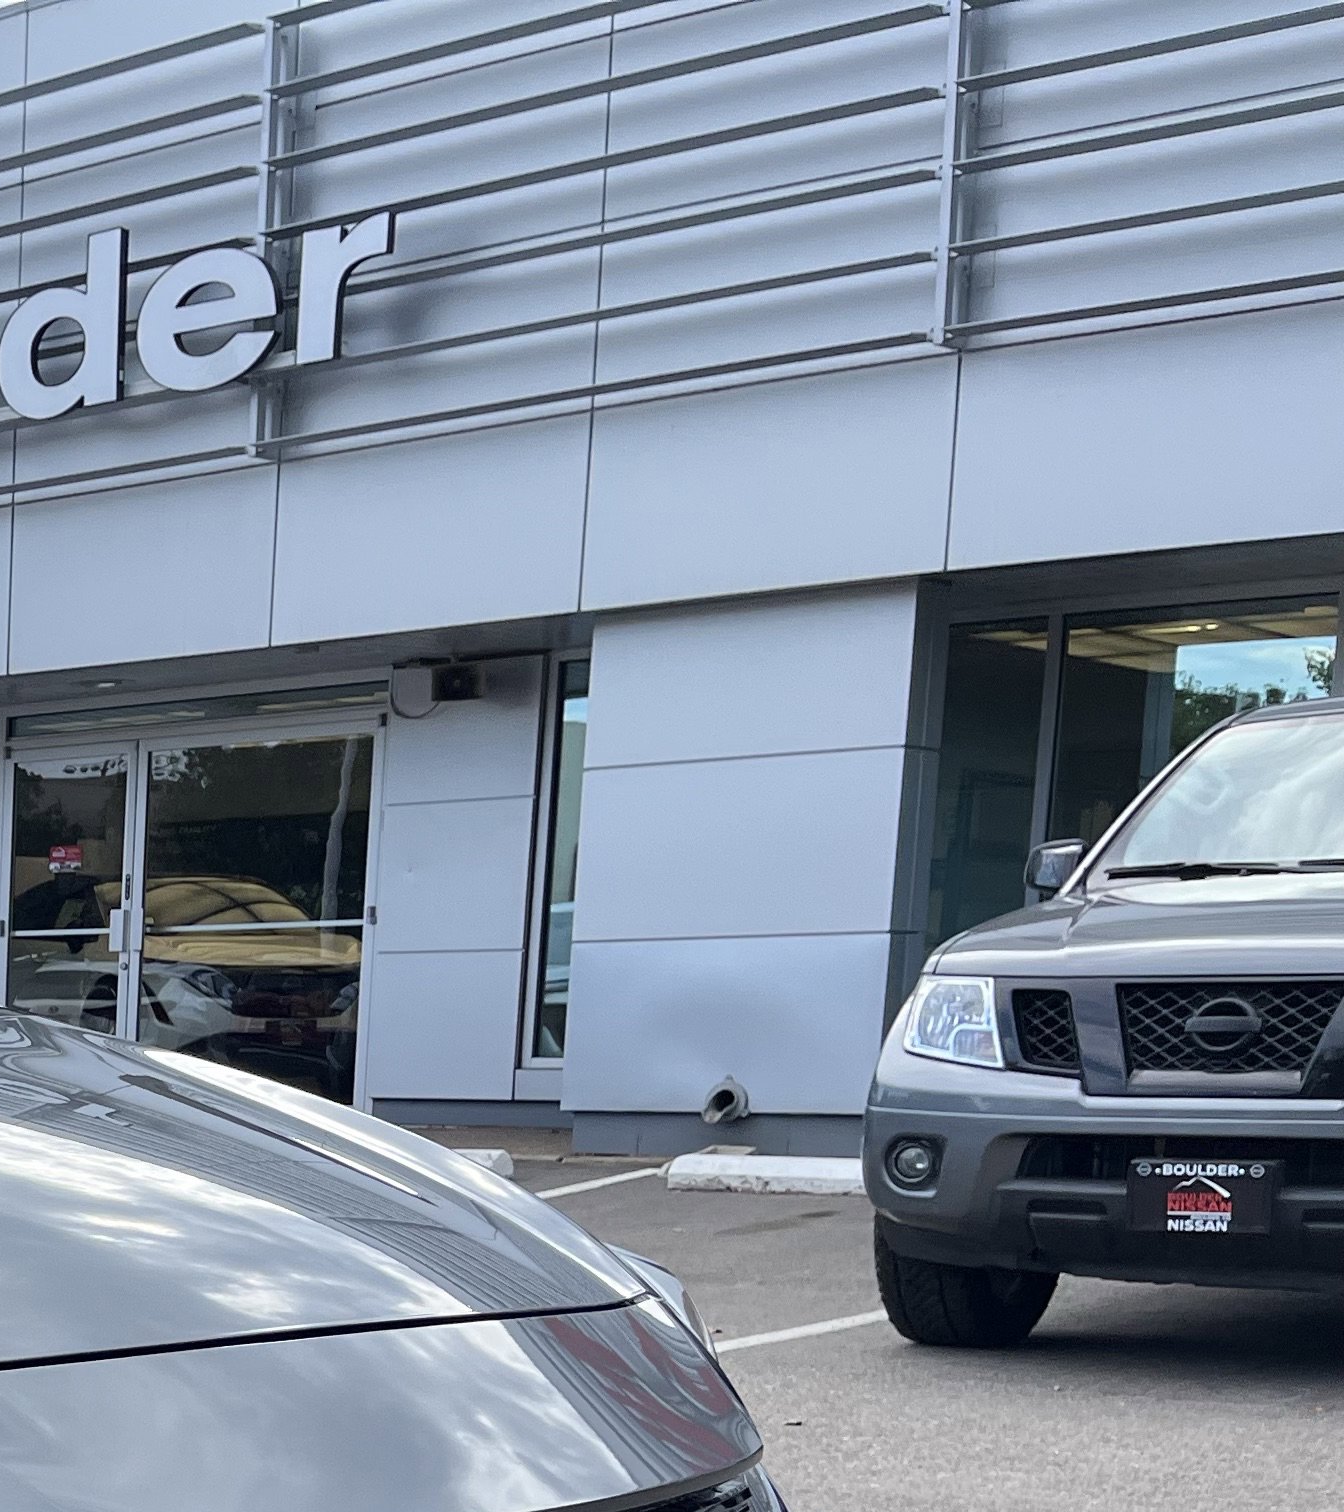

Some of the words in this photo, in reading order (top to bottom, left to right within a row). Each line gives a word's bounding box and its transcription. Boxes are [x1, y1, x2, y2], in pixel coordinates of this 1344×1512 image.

[1162, 1163, 1239, 1177] BOULDER
[1167, 1199, 1233, 1213] NISSAN
[1167, 1219, 1228, 1232] NISSAN
